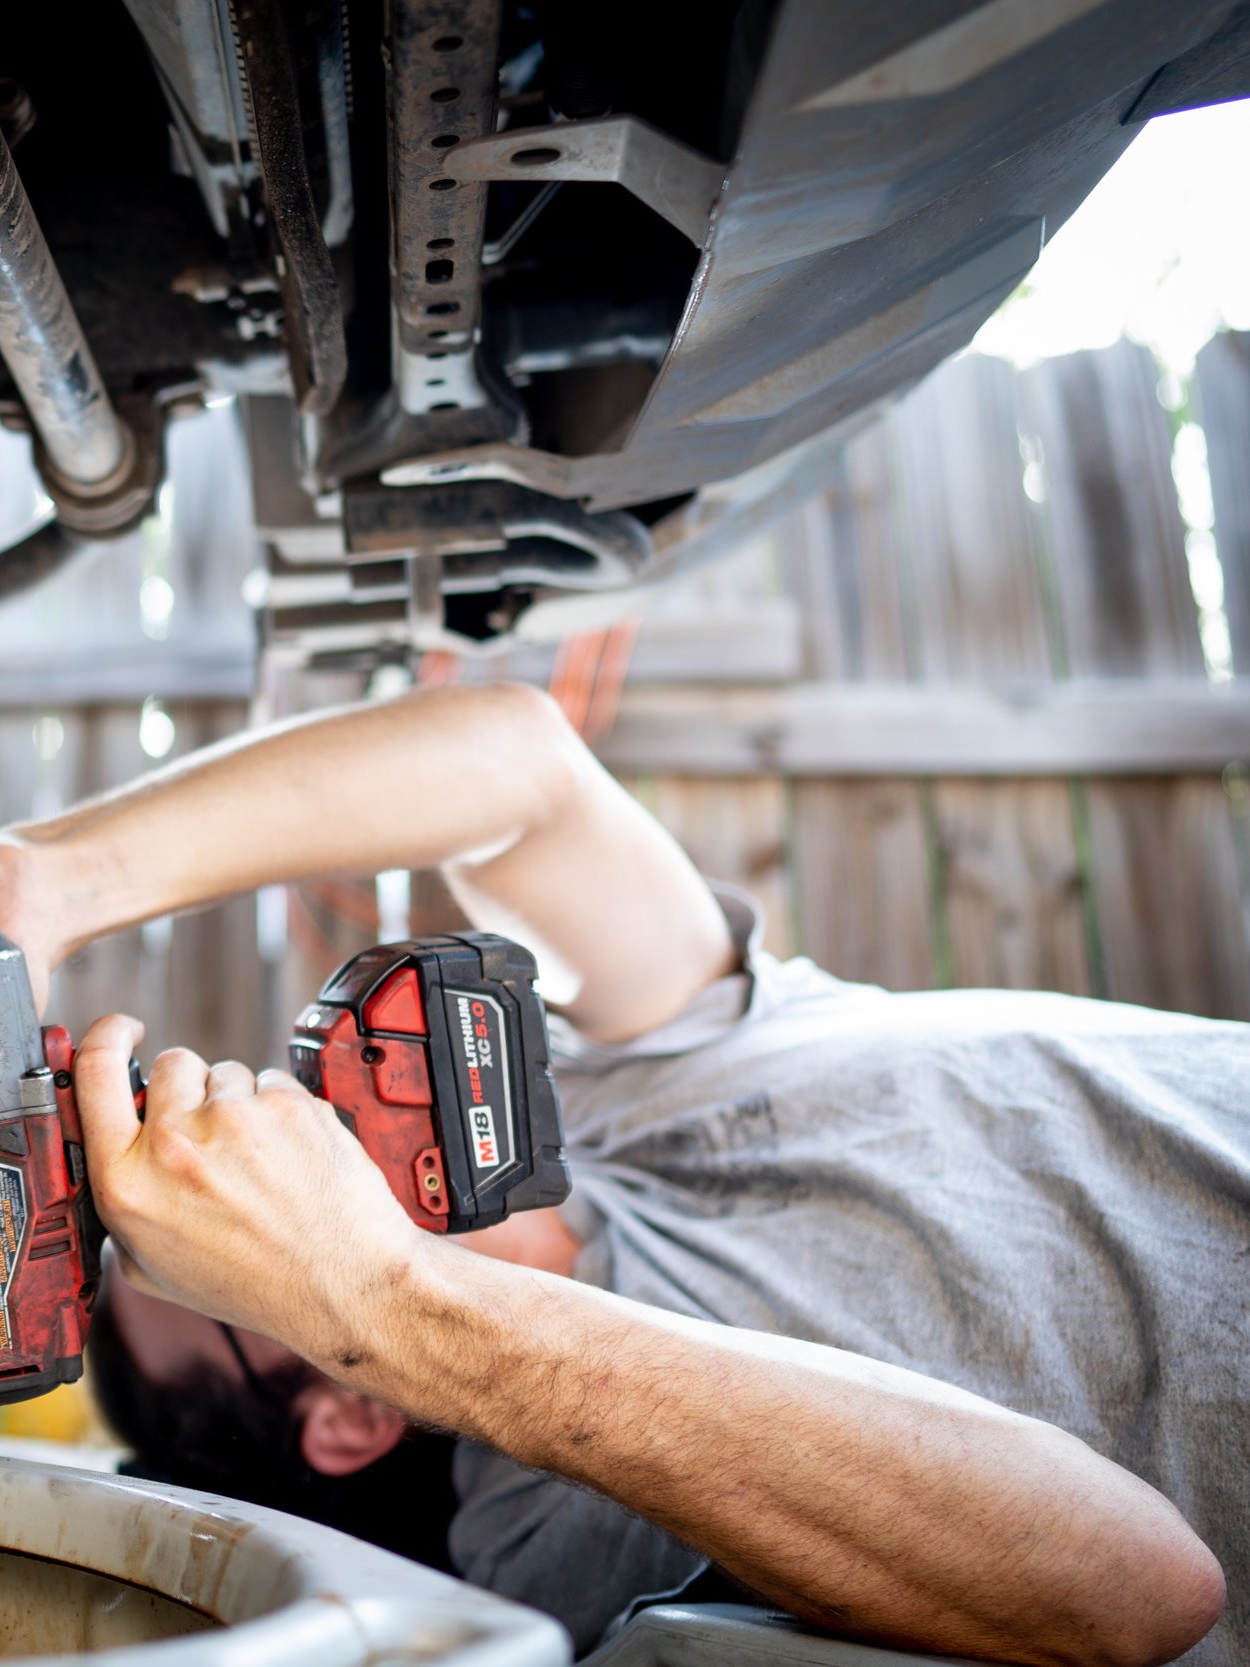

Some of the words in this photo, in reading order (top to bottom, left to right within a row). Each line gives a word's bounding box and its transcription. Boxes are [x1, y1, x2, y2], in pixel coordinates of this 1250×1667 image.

[457, 998, 484, 1104] REDLITHIUM
[472, 1002, 493, 1069] XC5.0
[475, 1112, 495, 1162] M18
